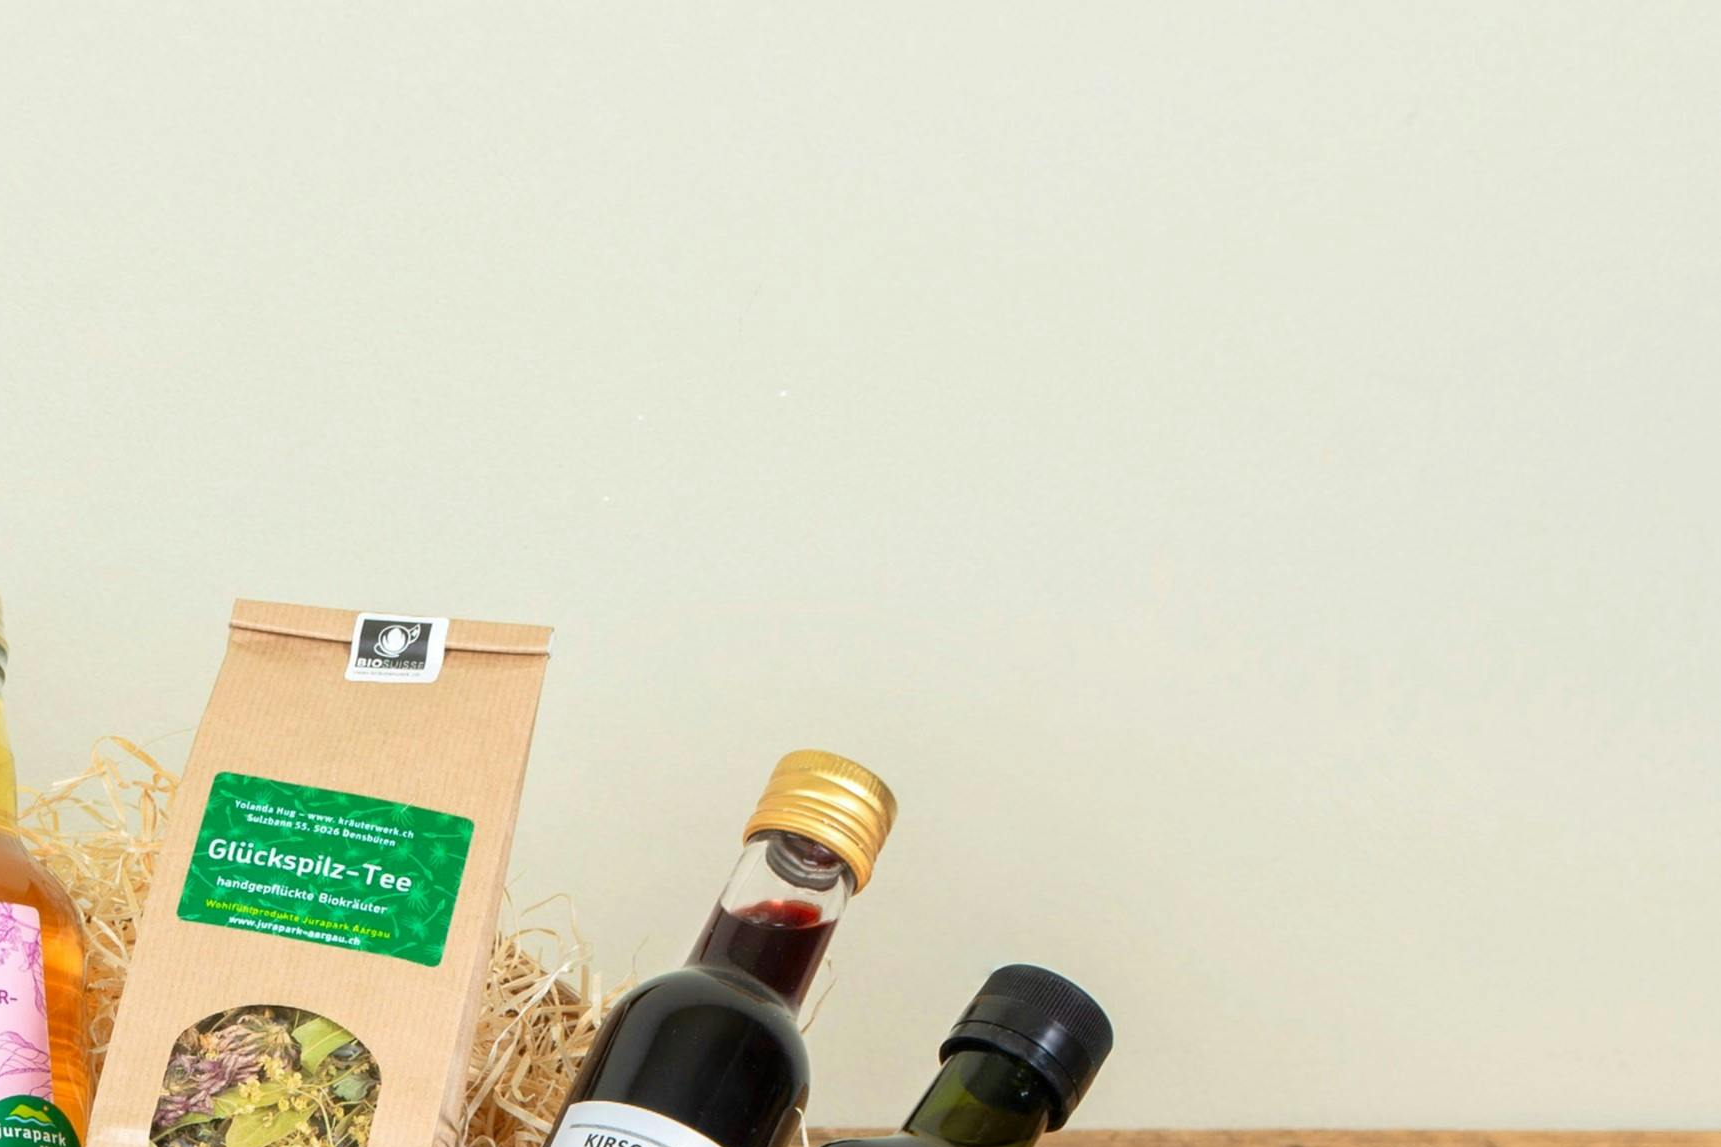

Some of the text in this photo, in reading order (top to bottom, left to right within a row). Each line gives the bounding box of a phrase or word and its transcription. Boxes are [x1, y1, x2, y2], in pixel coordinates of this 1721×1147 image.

[234, 799, 275, 815] Yolanda
[276, 806, 297, 820] Hug
[338, 815, 416, 840] kräuterwerk.ch
[246, 812, 293, 829] Sulzbann
[342, 828, 397, 848] Densbüren
[207, 837, 413, 893] Glückspilz-Tee
[215, 875, 389, 916] handgepflückte Biokräuter
[227, 915, 362, 947] www.jurapark-aargau.ch
